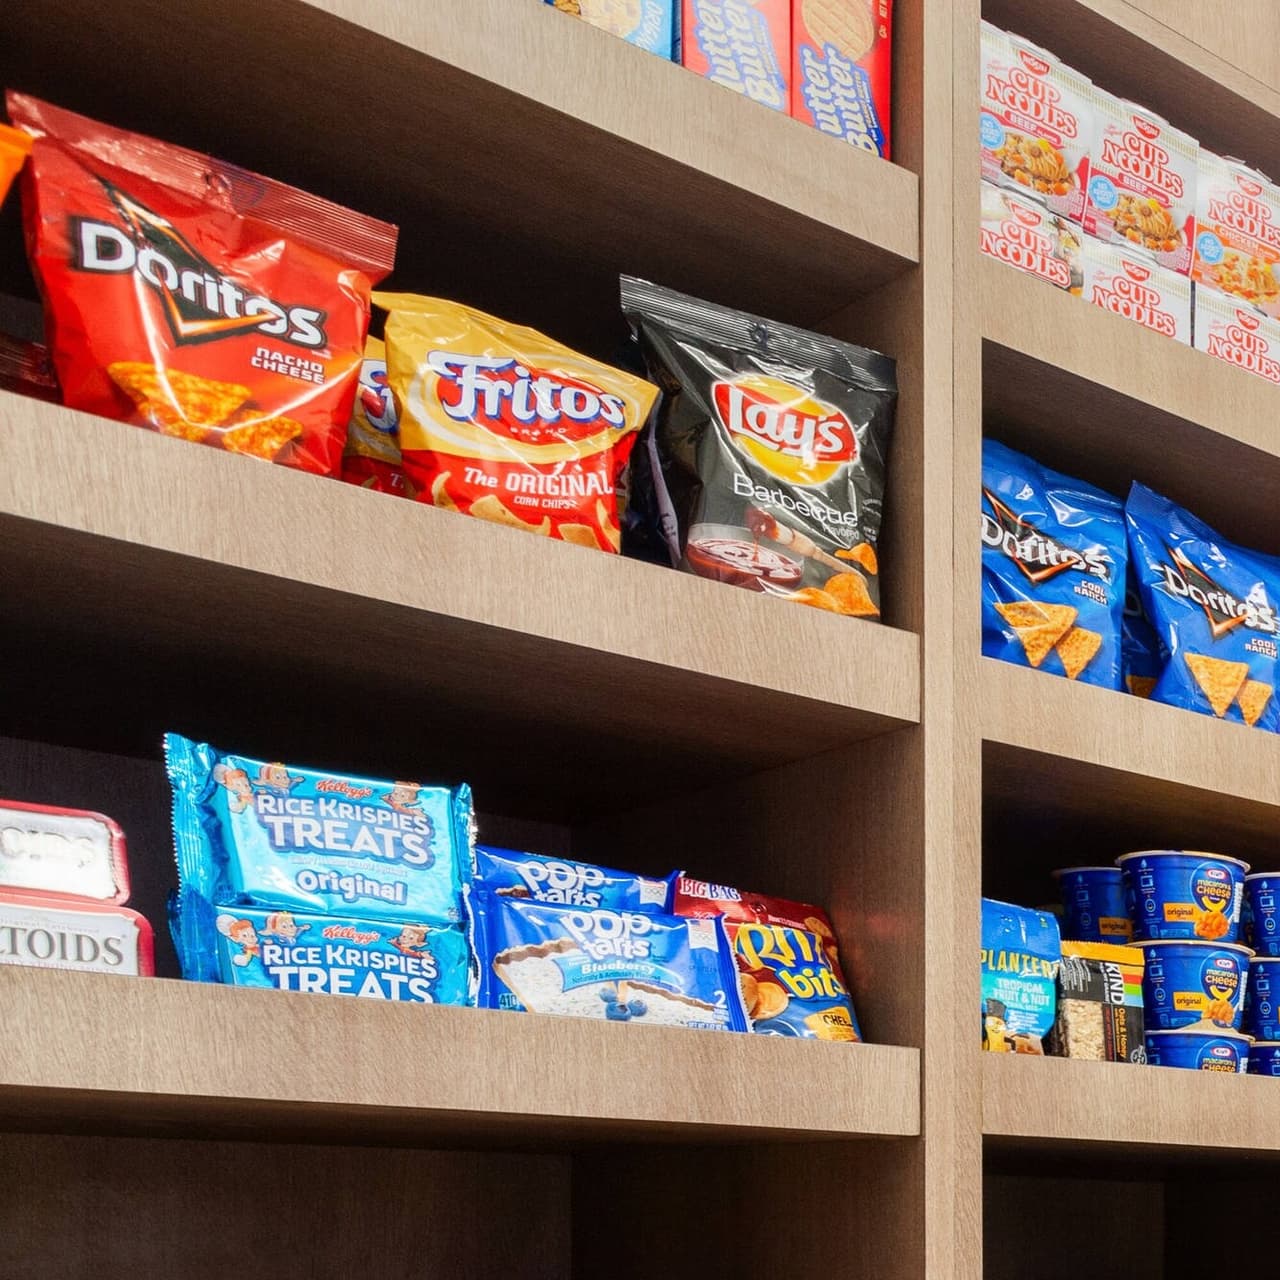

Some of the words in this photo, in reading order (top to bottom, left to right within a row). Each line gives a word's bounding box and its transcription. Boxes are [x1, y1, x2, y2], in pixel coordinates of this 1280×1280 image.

[1009, 66, 1061, 103] CUP
[987, 75, 1077, 138] NOODLES
[1123, 132, 1169, 165] CUP
[1103, 139, 1184, 198] NOODLES
[1124, 175, 1148, 194] BEEF
[1227, 190, 1272, 222] CUP
[1001, 220, 1054, 257] CUP
[981, 228, 1071, 288] NOODLES
[80, 220, 325, 347] Doritos
[1113, 274, 1161, 306] CUP
[1093, 286, 1176, 338] NOODLES
[1226, 324, 1269, 356] CUP
[251, 357, 325, 384] CHEESE
[256, 347, 324, 374] NACHO
[427, 351, 626, 428] Fritos
[728, 386, 846, 470] Lay's
[464, 467, 498, 488] The
[505, 470, 613, 496] ORIGINAL
[513, 495, 539, 507] CORN
[733, 473, 859, 528] Barbecue
[982, 513, 1111, 579] Doritos
[1073, 586, 1108, 605] RANCH
[1081, 579, 1106, 595] COOL
[1164, 565, 1276, 634] Doritos
[1245, 643, 1278, 659] RANCH
[1251, 638, 1277, 651] COOL
[315, 778, 374, 799] Kellogg's
[257, 795, 313, 817] RICE
[314, 797, 431, 835] KRISPIES
[262, 815, 429, 866] TREATS
[297, 870, 406, 904] Original
[679, 876, 707, 897] BIG
[707, 882, 742, 902] BAG
[1, 926, 125, 967] TOIDS
[322, 925, 381, 944] Kellogg's
[264, 946, 319, 966] RICE
[321, 946, 438, 980] KRISPIES
[581, 961, 656, 976] Blueberry
[1104, 962, 1125, 1006] KIND
